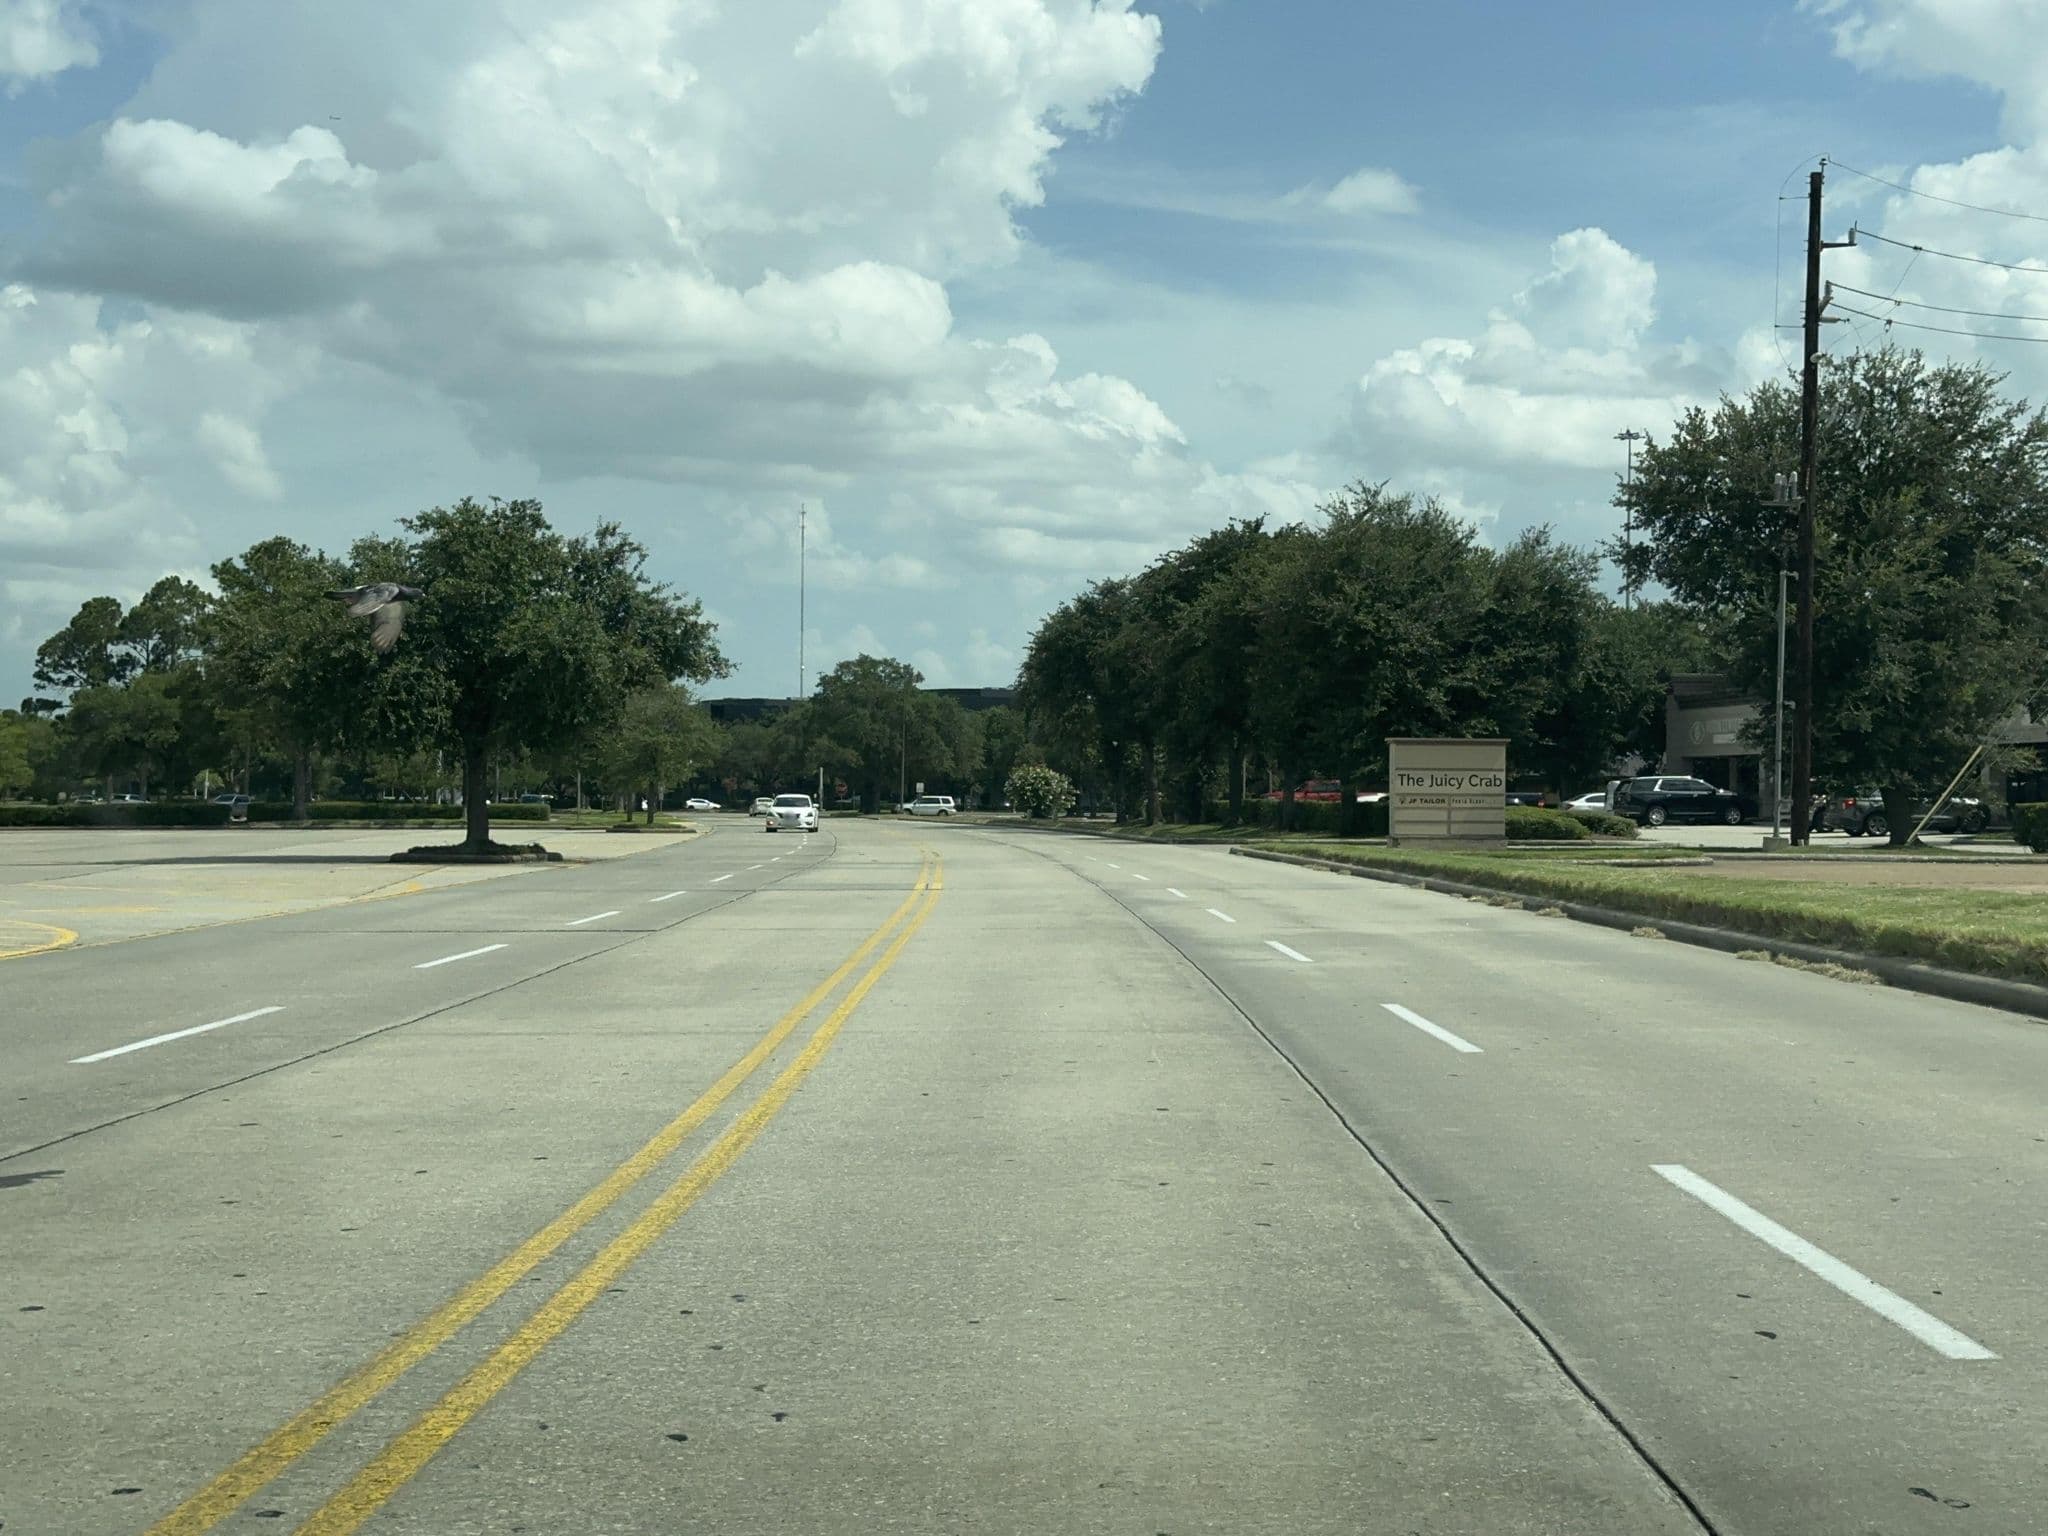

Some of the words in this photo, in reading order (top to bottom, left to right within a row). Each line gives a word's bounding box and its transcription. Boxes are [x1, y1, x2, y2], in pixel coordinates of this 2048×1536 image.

[1397, 773, 1424, 786] The
[1429, 773, 1464, 789] Juicy
[1468, 774, 1502, 787] Crab
